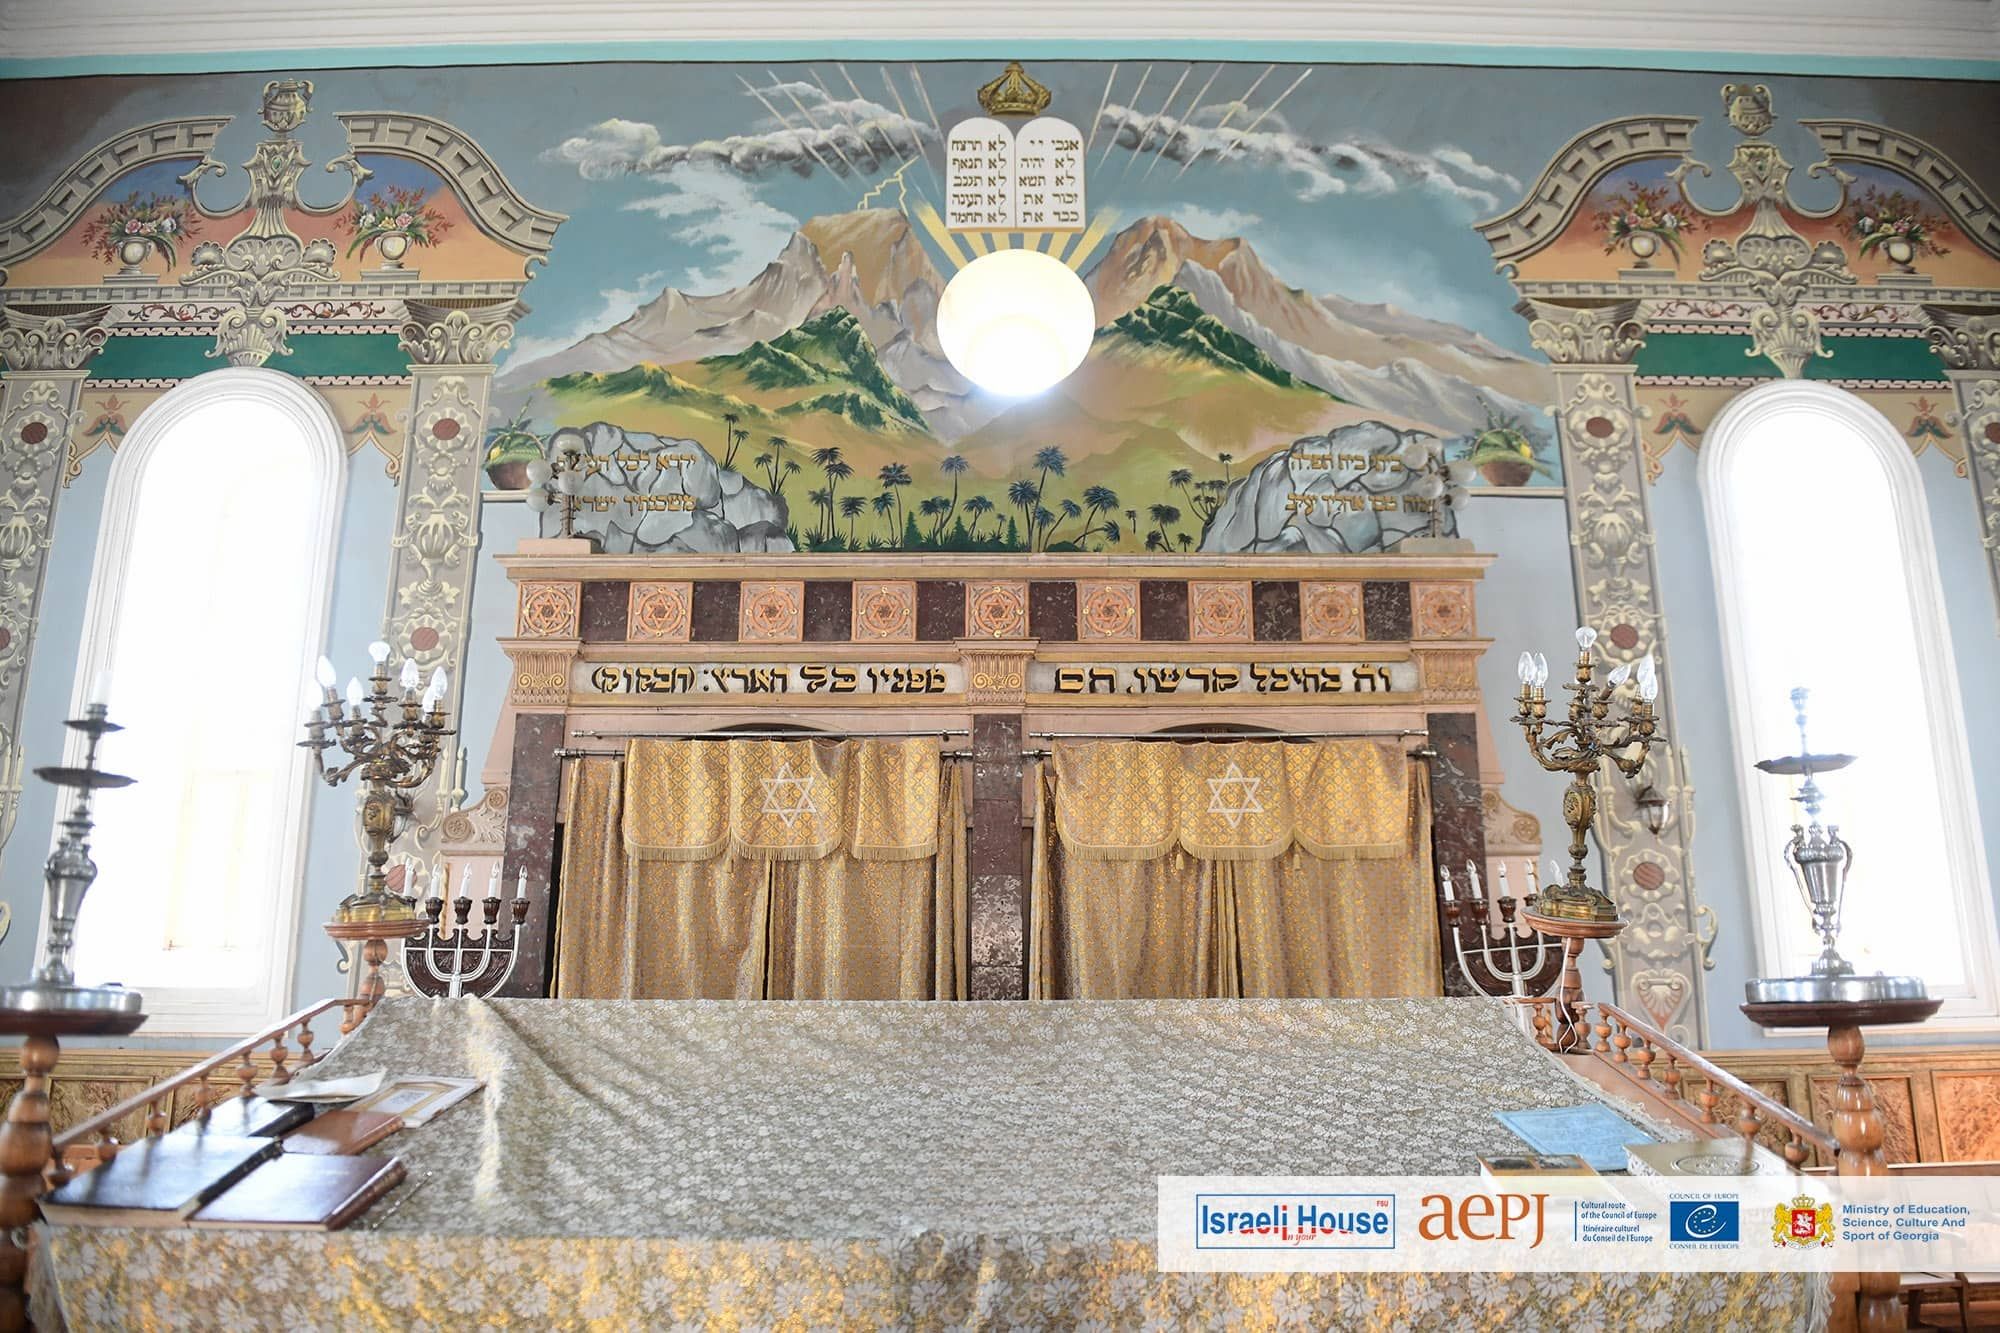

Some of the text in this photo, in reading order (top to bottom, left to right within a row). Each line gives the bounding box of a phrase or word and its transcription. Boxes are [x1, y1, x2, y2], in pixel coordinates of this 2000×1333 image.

[951, 134, 1007, 151] לא תרצח
[1051, 140, 1079, 151] אנכי
[952, 152, 1007, 172] לא תנאף
[1020, 154, 1075, 169] לא יהיה
[988, 170, 1007, 186] לא
[1019, 170, 1075, 187] לא תשא
[952, 188, 1007, 208] לא תענה
[1023, 193, 1079, 204] זכור את
[950, 207, 1007, 223] לא תחמד
[1023, 211, 1080, 223] כבד את
[617, 450, 650, 471] לכל
[656, 454, 697, 474] יקרא
[1291, 448, 1334, 470] תפלה
[1338, 454, 1365, 470] בית
[623, 495, 697, 517] משכנתיך
[799, 664, 857, 694] כל
[867, 667, 948, 694] מפניו
[1054, 667, 1117, 694] הס
[1250, 662, 1342, 693] בהיכל
